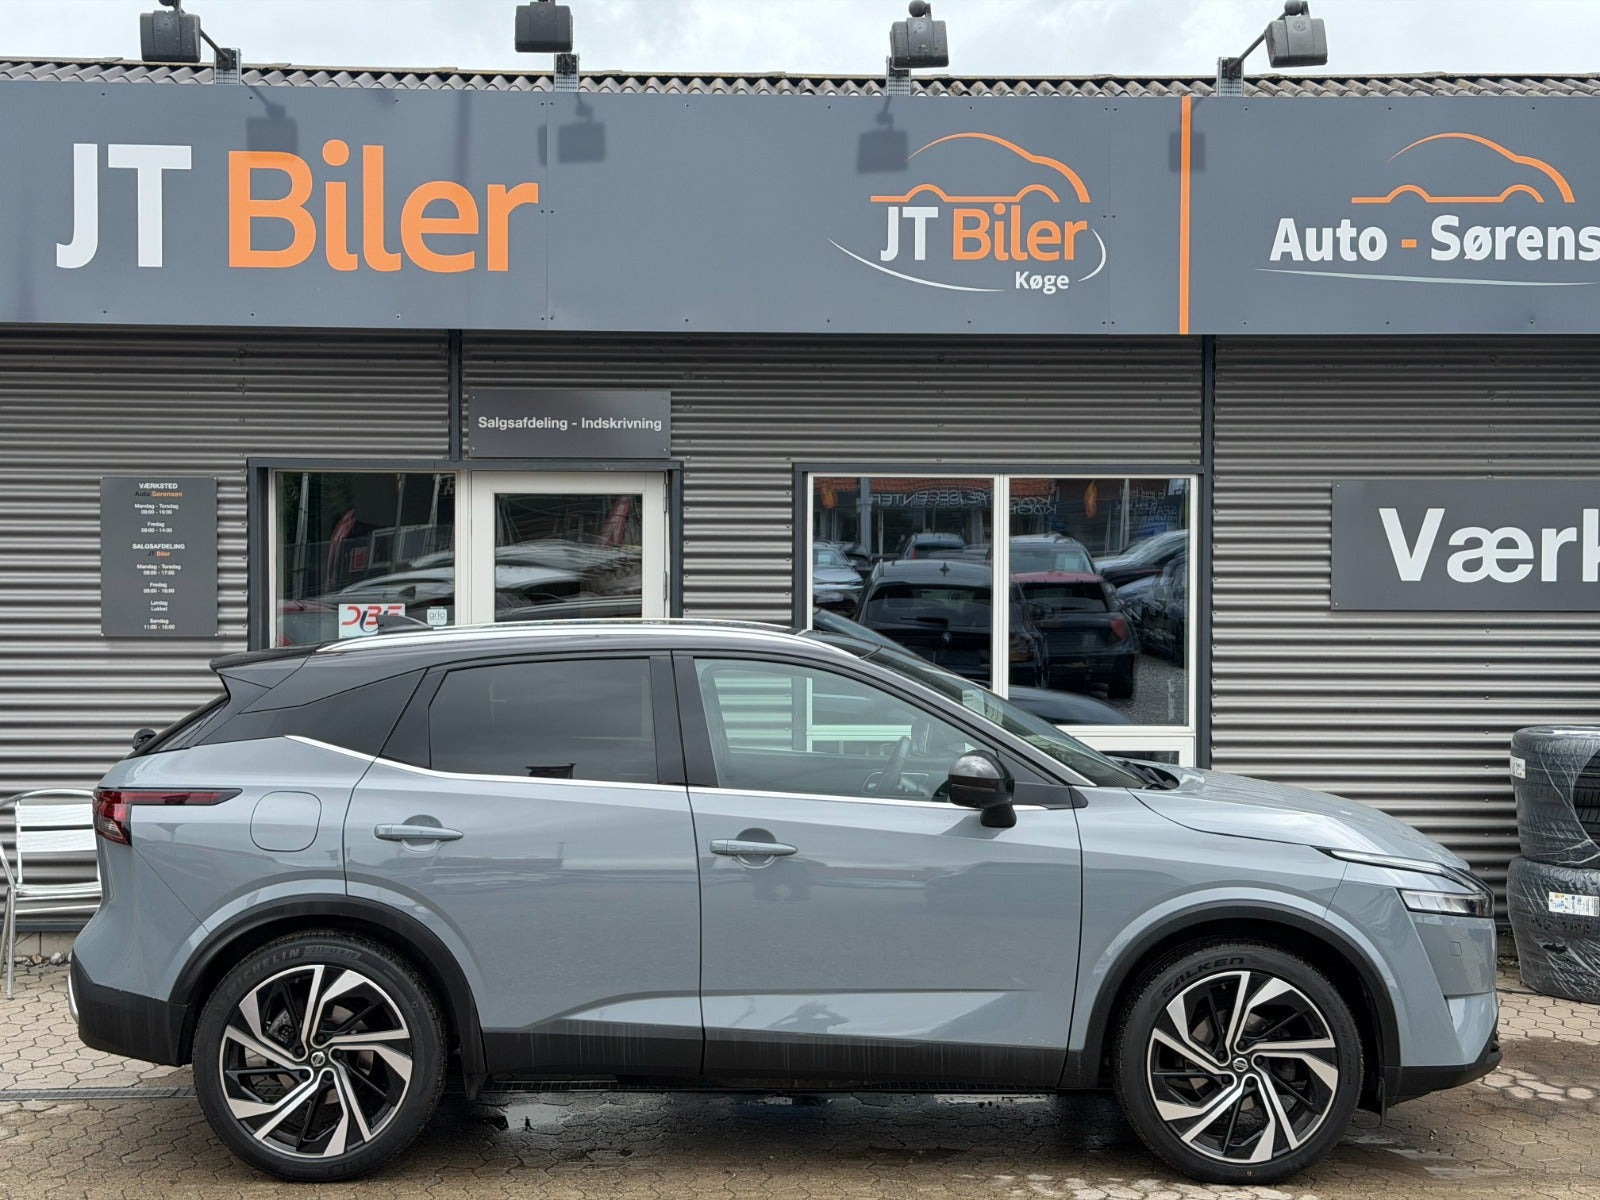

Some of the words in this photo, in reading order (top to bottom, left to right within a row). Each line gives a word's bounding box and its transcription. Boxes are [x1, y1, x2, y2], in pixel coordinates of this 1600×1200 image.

[56, 143, 192, 269] JT
[227, 139, 539, 273] Biler
[880, 206, 939, 261] JT
[952, 202, 1088, 262] Biler
[1269, 217, 1388, 262] Auto
[1015, 271, 1070, 295] Køge
[478, 416, 569, 432] Salgsafdeling
[581, 416, 663, 432] Indskrivning
[138, 482, 179, 490] VÆRKSTED
[151, 490, 183, 498] Sørensen
